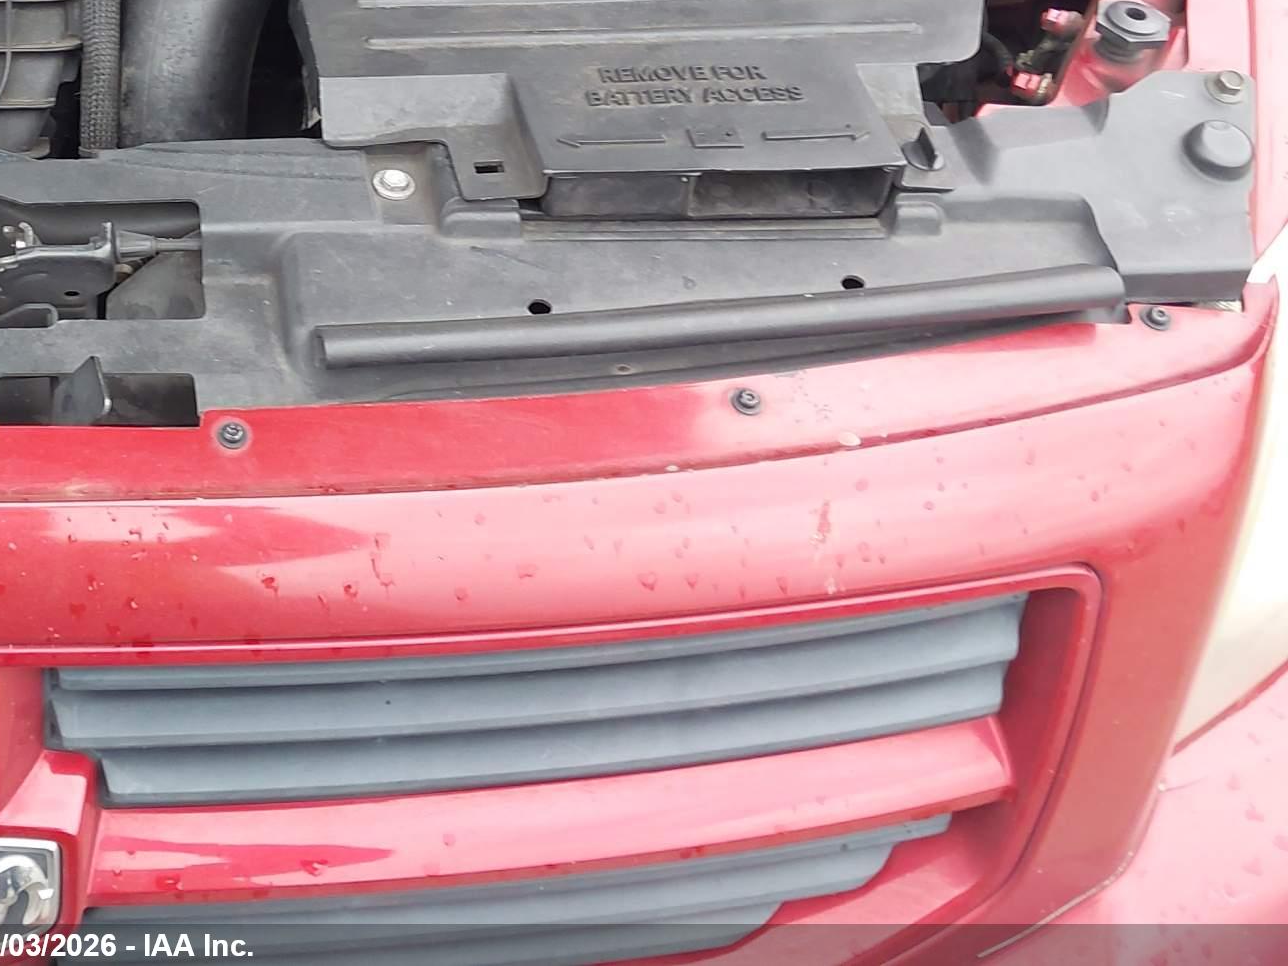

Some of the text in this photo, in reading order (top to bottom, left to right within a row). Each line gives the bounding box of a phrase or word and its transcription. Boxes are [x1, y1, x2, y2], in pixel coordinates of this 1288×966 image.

[597, 65, 767, 84] REMOVE FOR
[584, 86, 805, 107] BATTERY ACCESS
